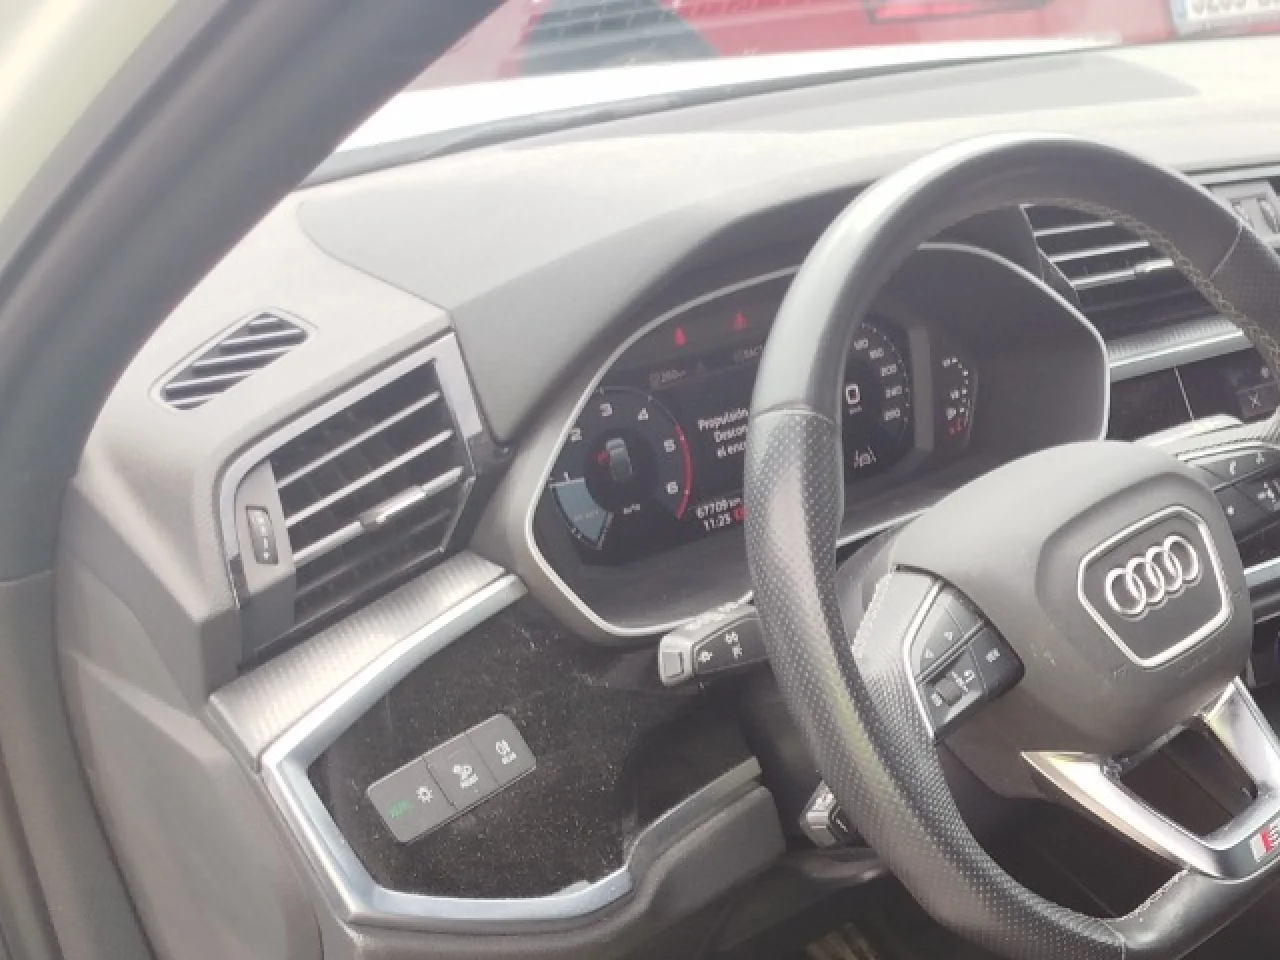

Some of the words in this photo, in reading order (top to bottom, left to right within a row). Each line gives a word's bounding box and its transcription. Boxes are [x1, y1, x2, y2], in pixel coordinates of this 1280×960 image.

[600, 403, 612, 417] 3
[638, 408, 649, 421] 4
[570, 428, 582, 442] 2
[664, 439, 676, 452] 5
[666, 481, 679, 494] 6
